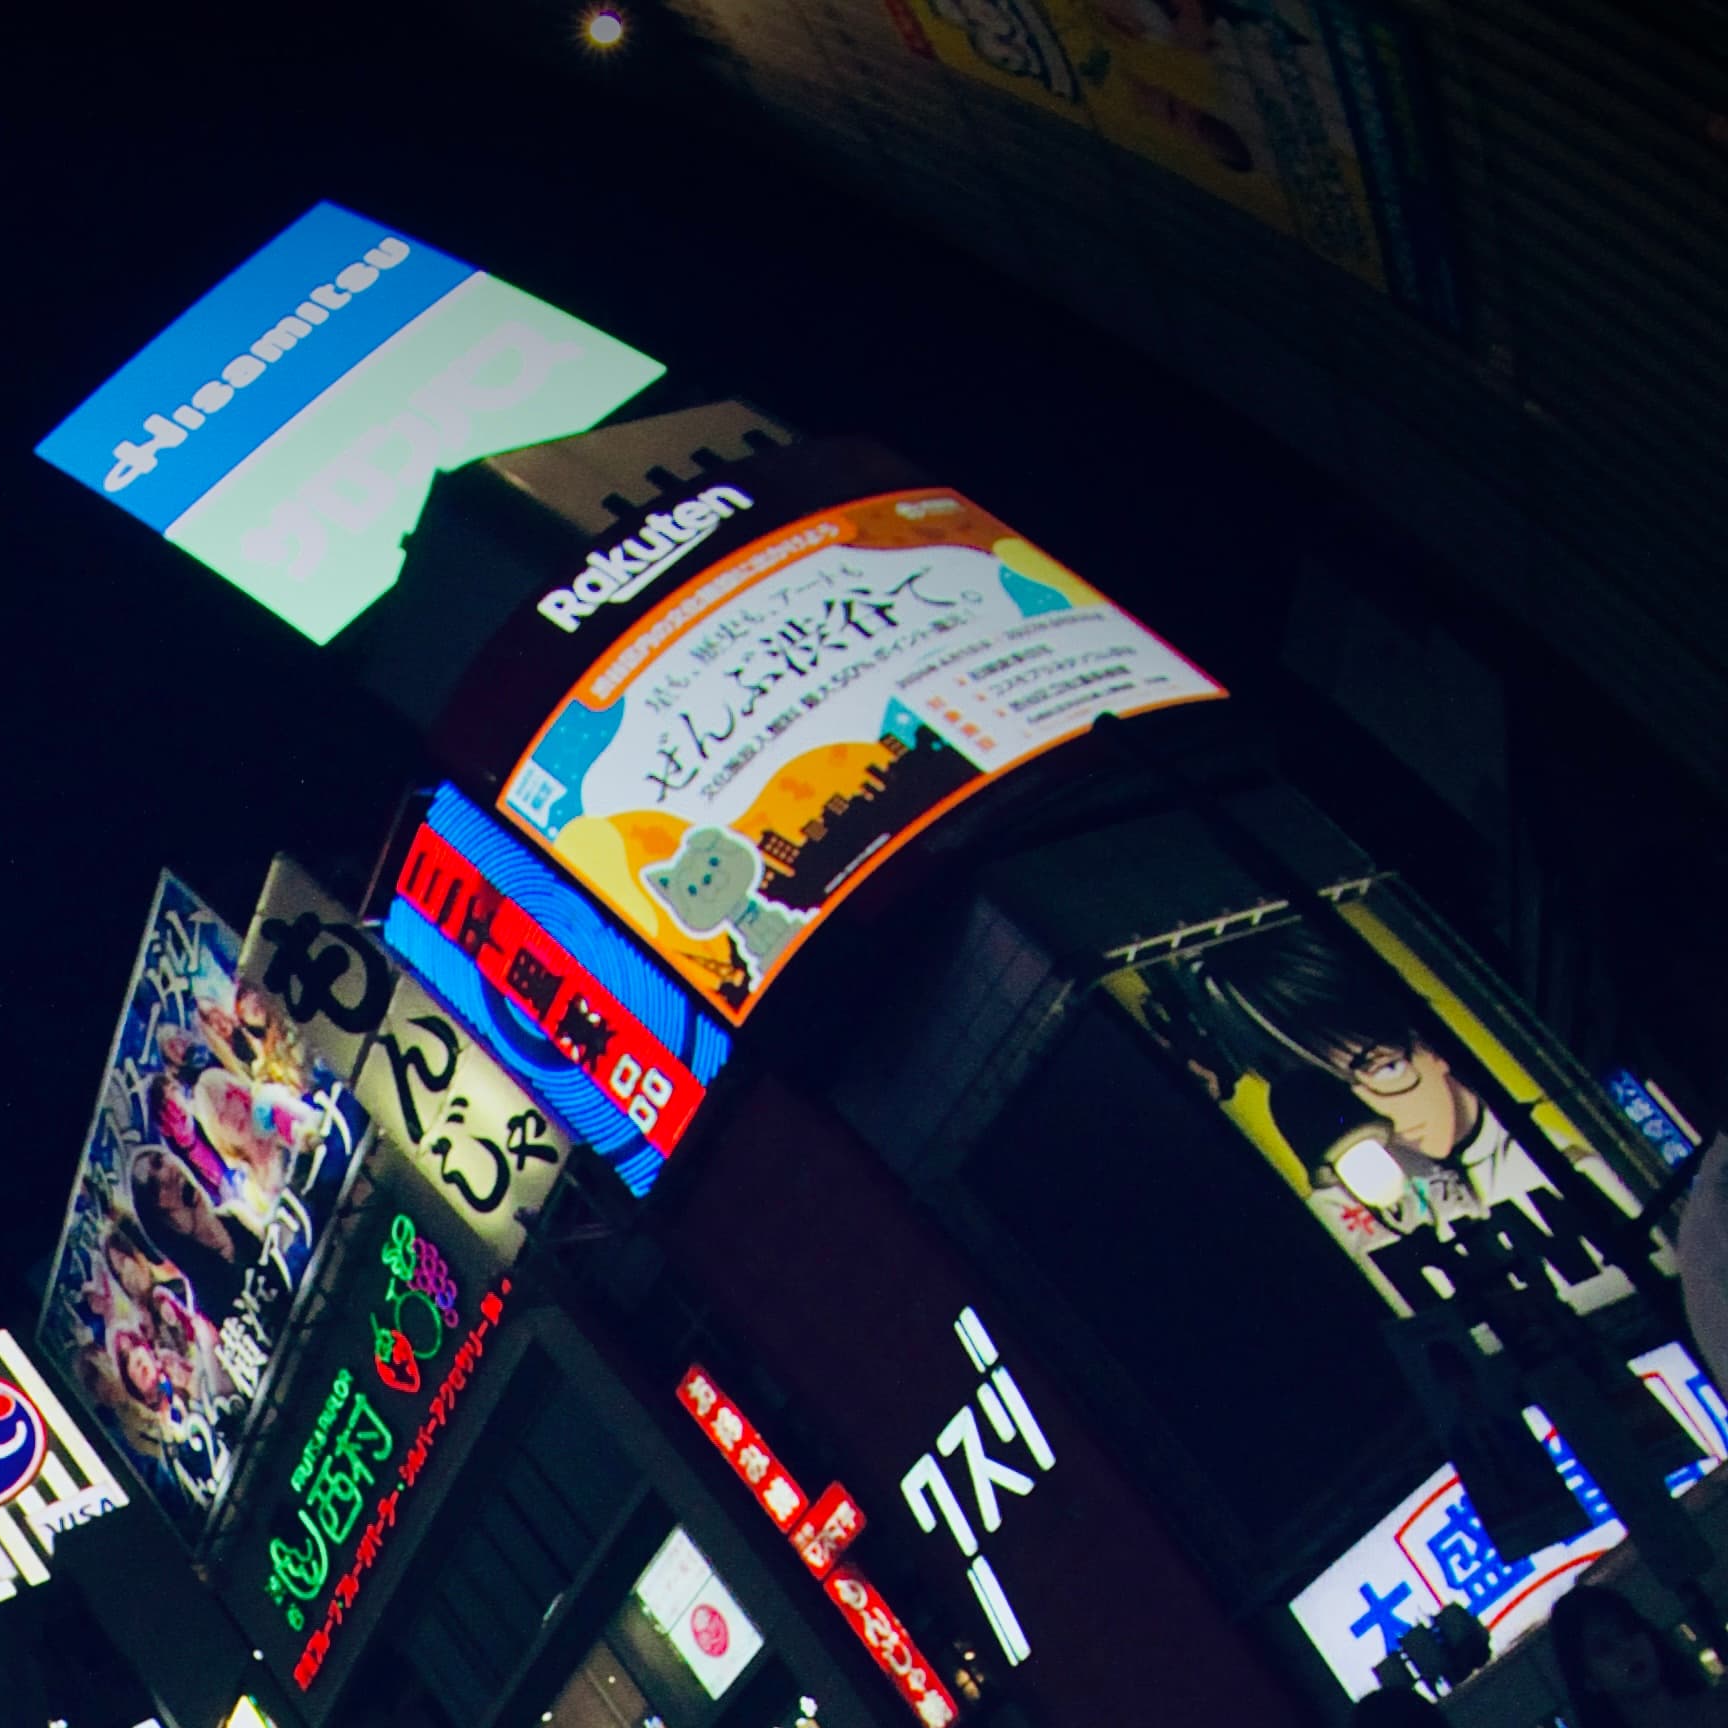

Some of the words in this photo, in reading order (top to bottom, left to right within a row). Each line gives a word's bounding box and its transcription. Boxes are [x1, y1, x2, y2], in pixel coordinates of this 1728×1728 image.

[537, 484, 753, 631] Rakuten
[262, 912, 558, 1213] もんじゃ
[215, 1081, 351, 1398] 横浜アリーナ
[42, 1495, 117, 1533] VISA
[308, 1393, 392, 1544] 西村
[900, 1364, 1056, 1556] クスリ
